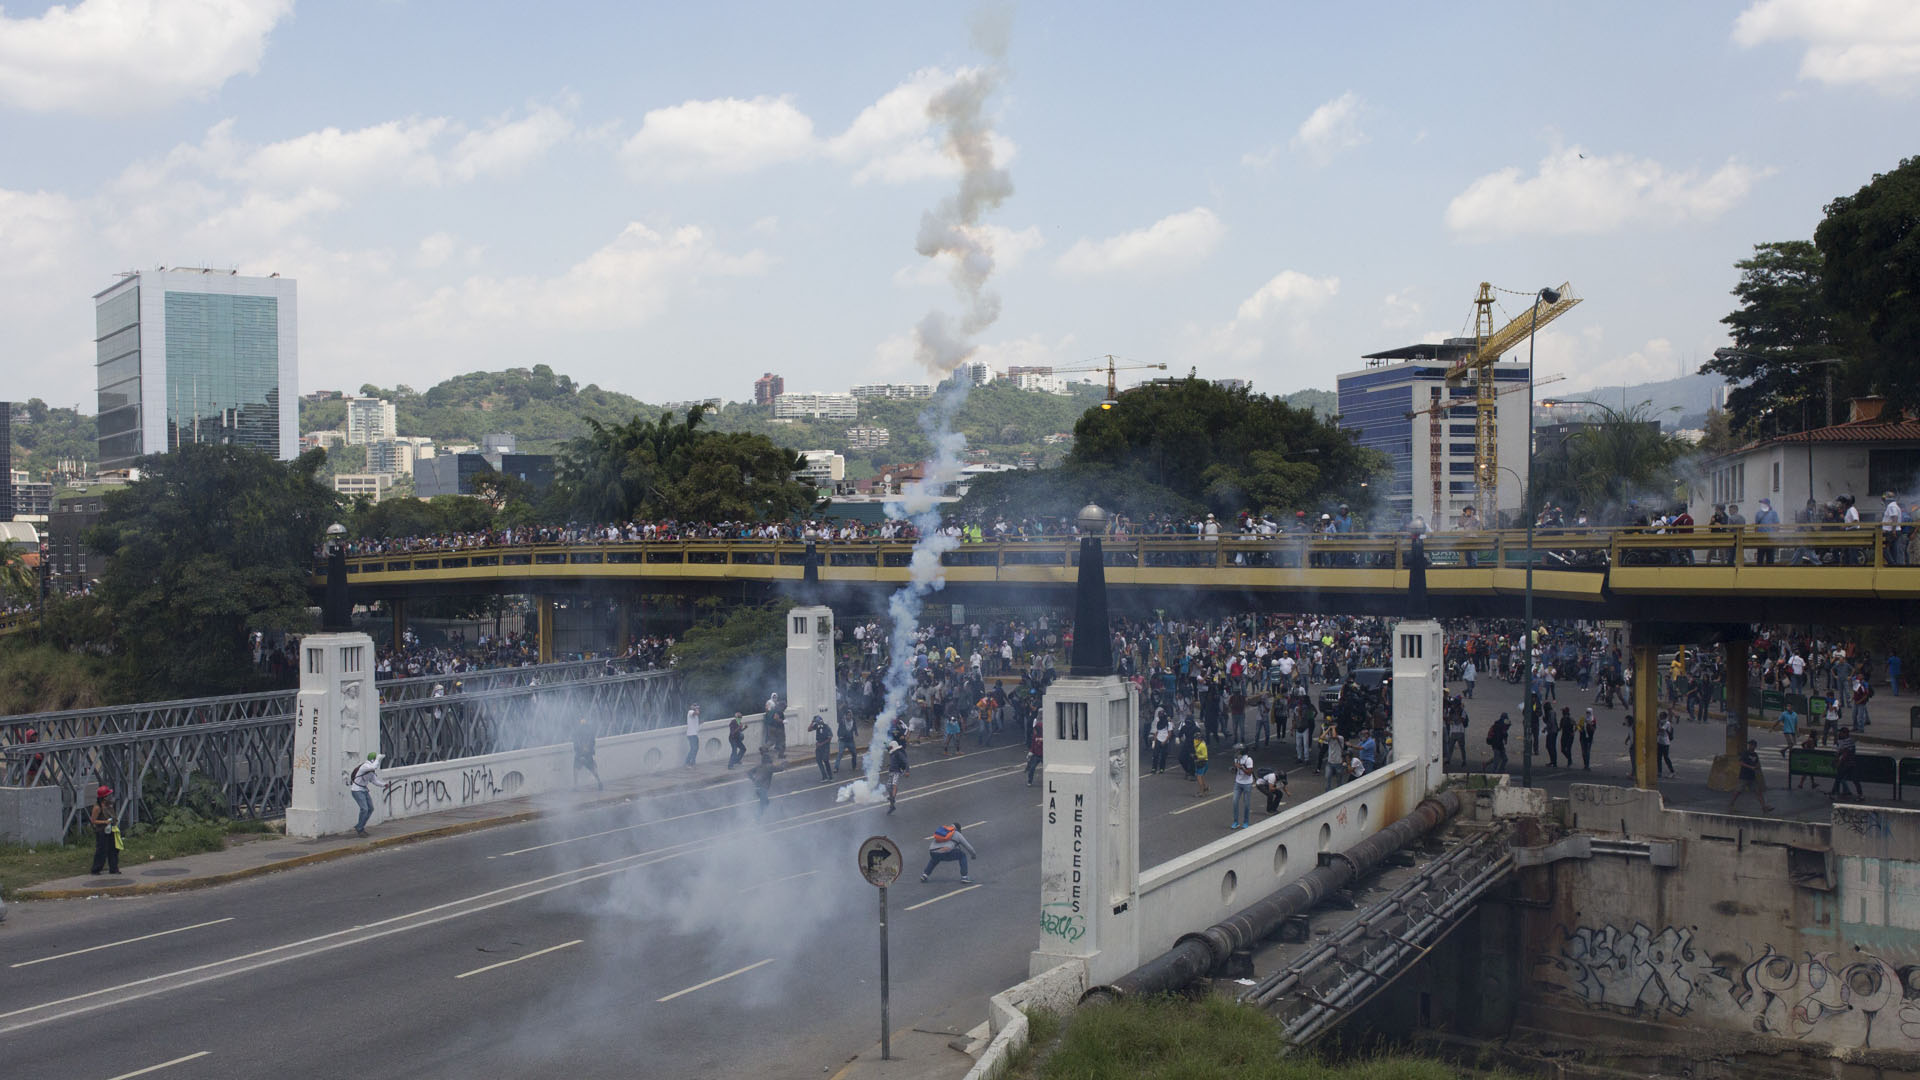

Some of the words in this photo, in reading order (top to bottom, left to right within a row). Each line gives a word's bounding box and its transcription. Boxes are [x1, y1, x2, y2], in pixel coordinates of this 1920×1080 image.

[310, 707, 319, 785] MERCEDES
[1048, 780, 1057, 825] LAS
[1072, 793, 1084, 913] MERCEDES
